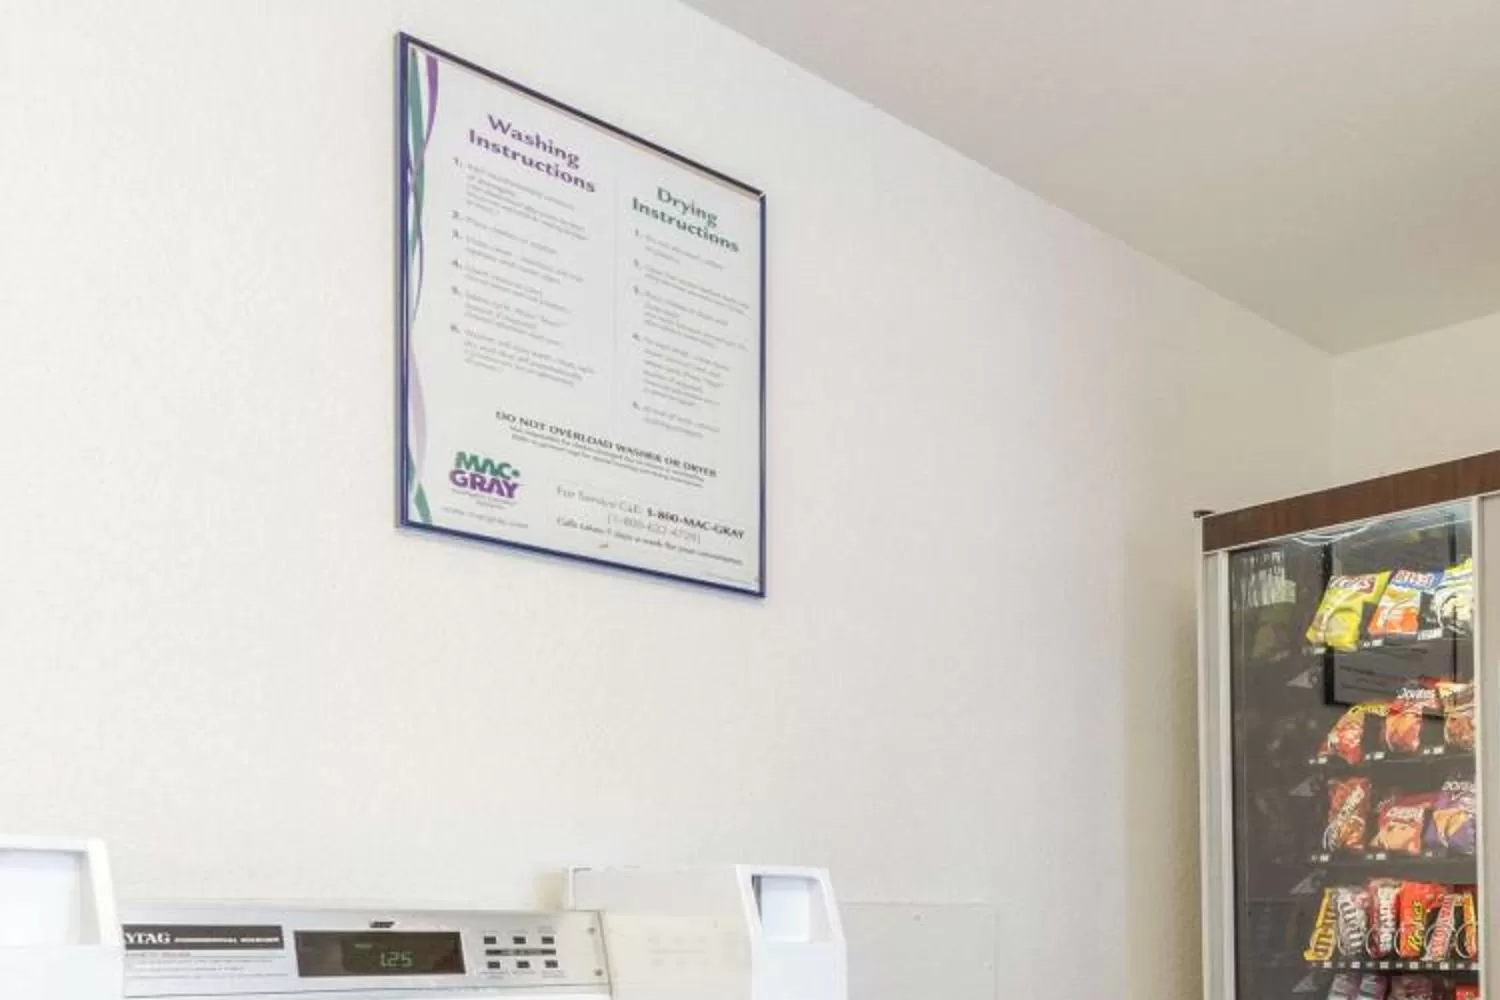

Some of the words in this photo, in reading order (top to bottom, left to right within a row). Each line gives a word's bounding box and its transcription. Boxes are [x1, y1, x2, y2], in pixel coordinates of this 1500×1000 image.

[468, 128, 596, 193] Instructions
[487, 112, 580, 170] Washing
[632, 196, 739, 253] Instructions
[657, 187, 718, 229] Drying
[449, 469, 519, 499] GRAY
[124, 931, 172, 945] YTAG
